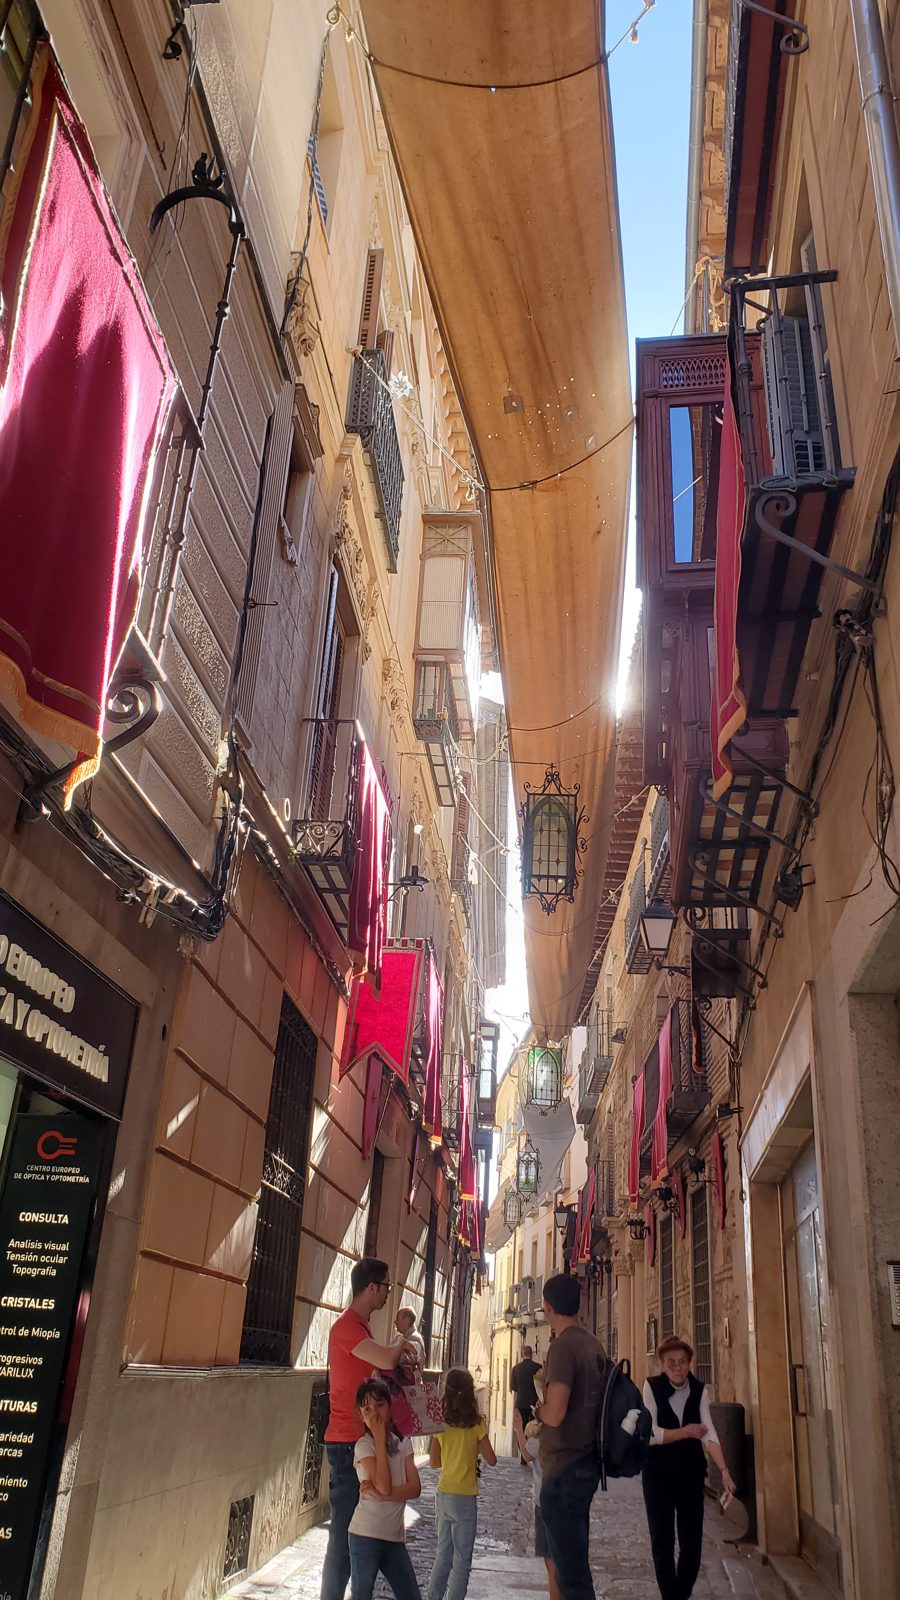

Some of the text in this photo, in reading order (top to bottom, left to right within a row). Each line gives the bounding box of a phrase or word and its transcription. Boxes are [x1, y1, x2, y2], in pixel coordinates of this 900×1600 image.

[6, 943, 76, 1013] EUROPEO
[15, 999, 31, 1031] Y
[26, 1009, 109, 1083] OPTOMETRÍA
[27, 1165, 80, 1174] CENTRO EUROPEO
[23, 1171, 45, 1181] ÓPTICA
[51, 1174, 90, 1184] OPTOMETRÍA
[19, 1212, 69, 1224] CONSULTA
[8, 1238, 70, 1251] Analisis visual
[6, 1251, 68, 1264] Tensión ocular
[12, 1264, 57, 1278] Topografía
[1, 1296, 55, 1309] CRISTALES
[0, 1326, 61, 1340] trol de Miopía
